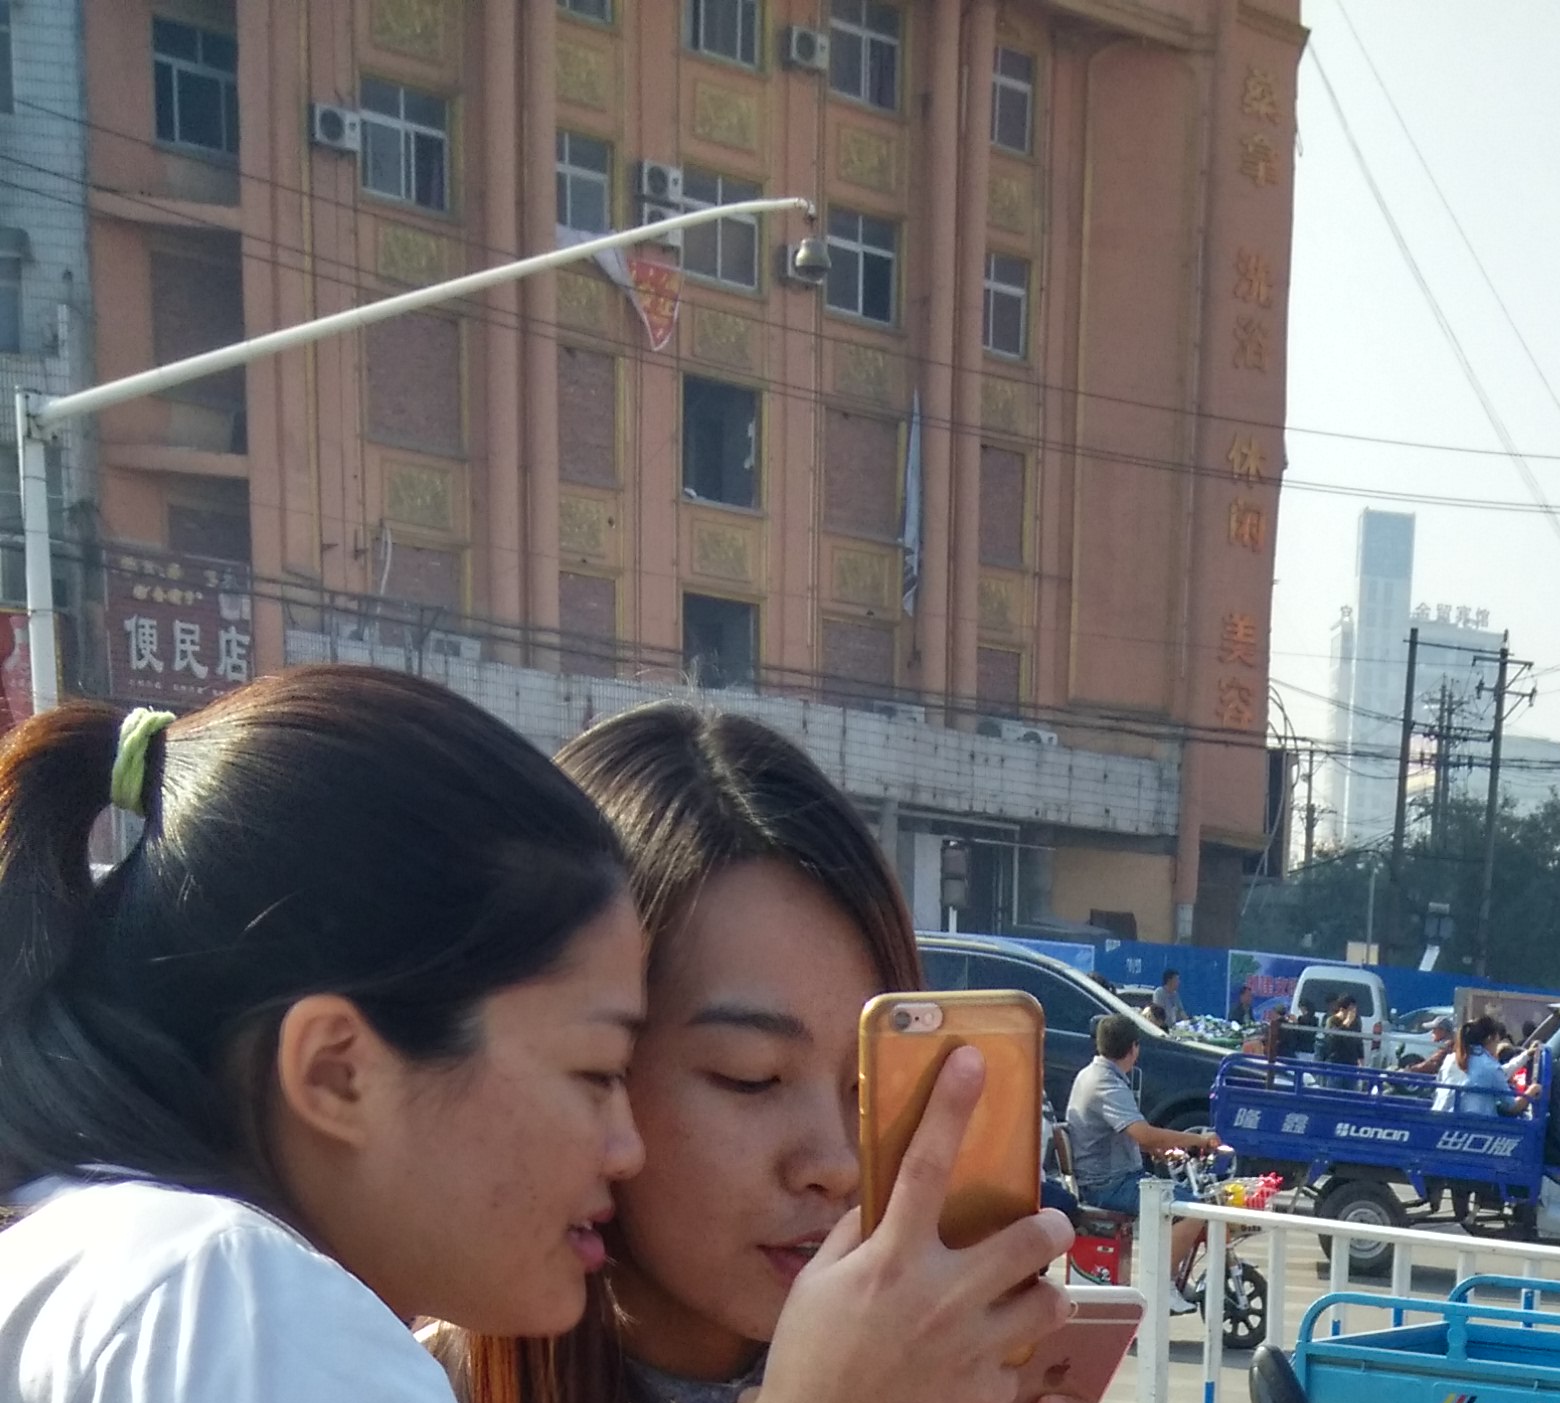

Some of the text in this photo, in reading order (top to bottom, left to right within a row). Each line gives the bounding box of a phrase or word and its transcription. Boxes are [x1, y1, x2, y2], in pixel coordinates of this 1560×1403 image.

[1226, 432, 1268, 554] 休闲
[124, 614, 251, 679] 便民店
[1215, 612, 1257, 732] 美容
[1436, 1131, 1523, 1158] 出口版
